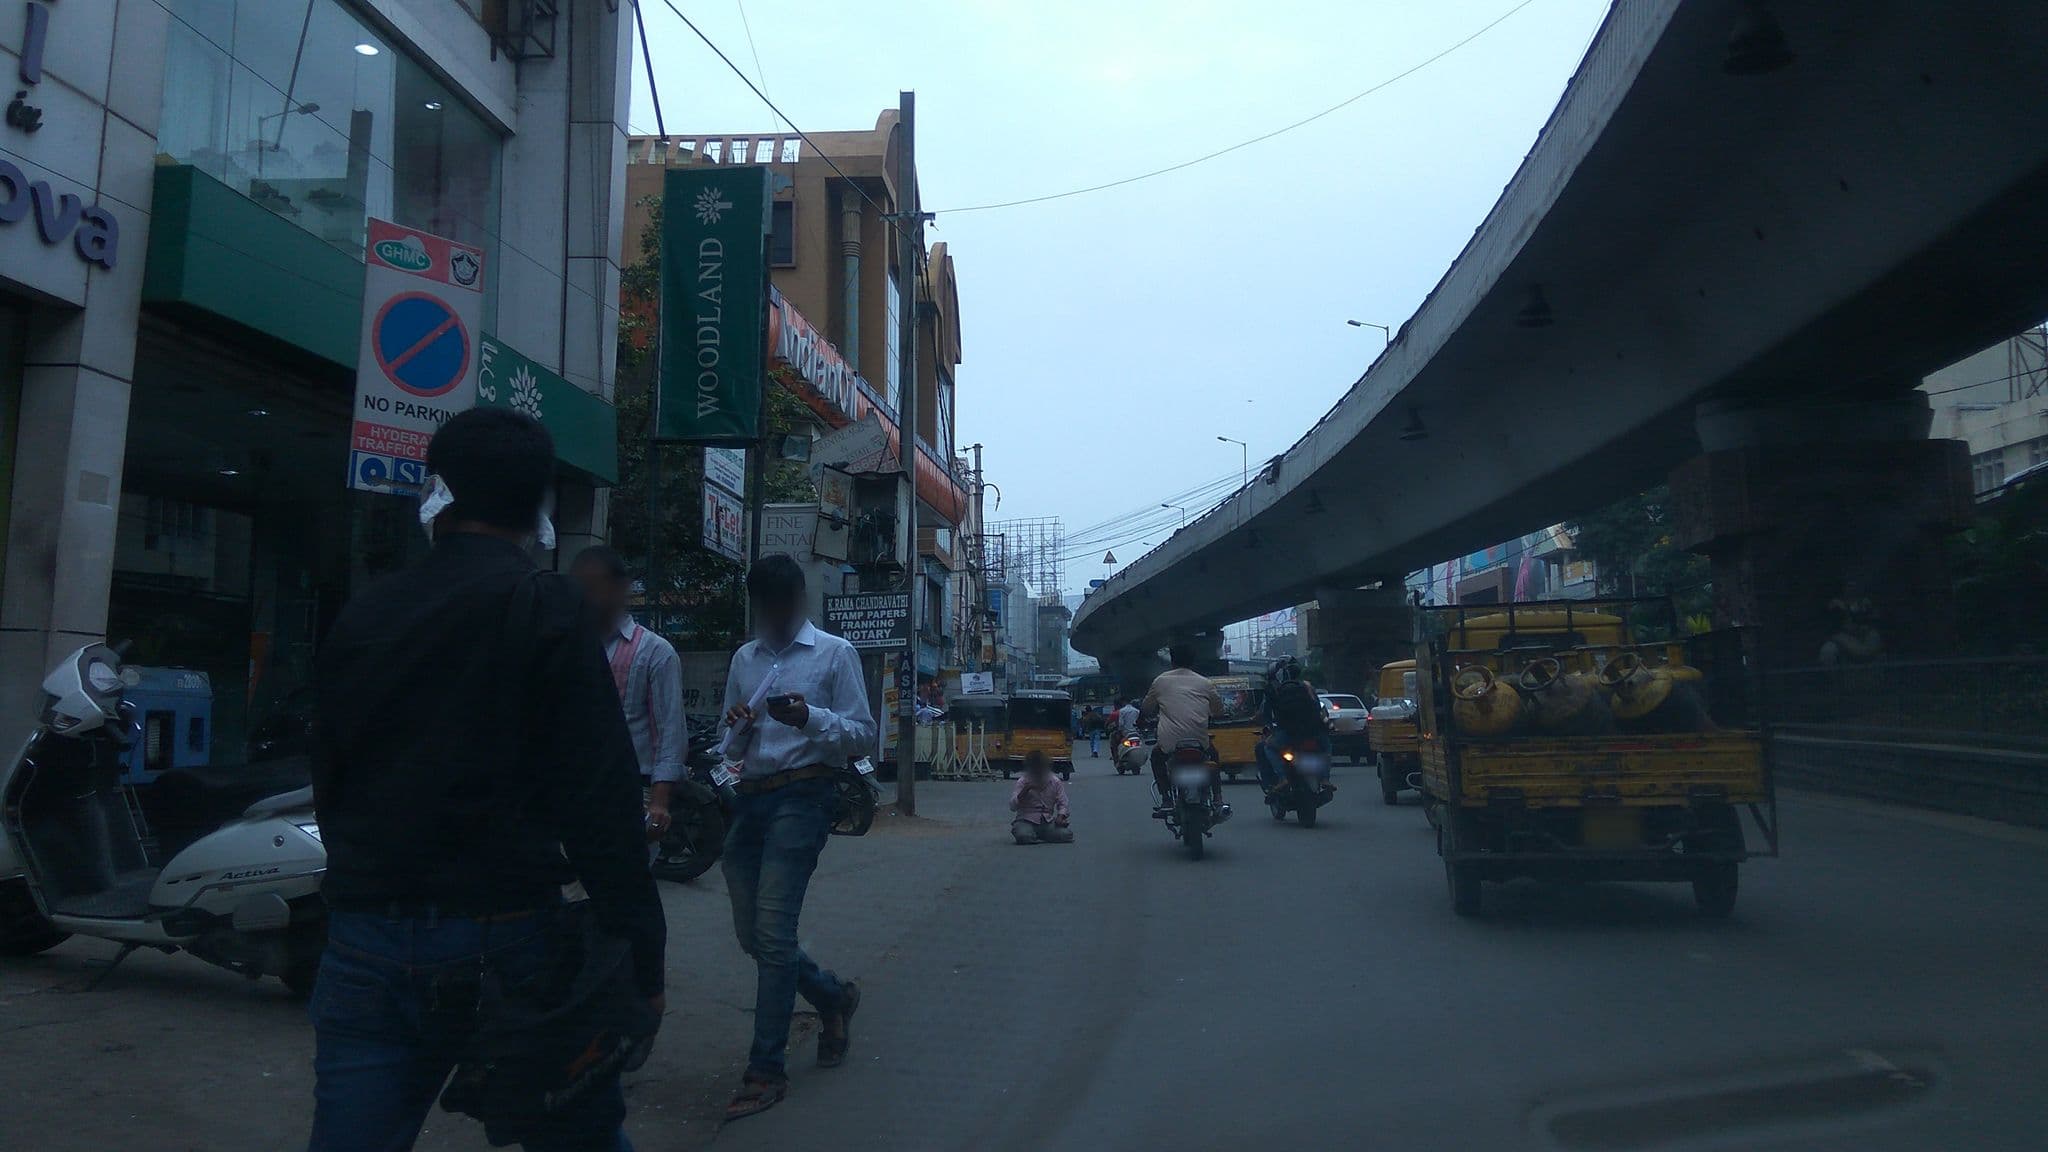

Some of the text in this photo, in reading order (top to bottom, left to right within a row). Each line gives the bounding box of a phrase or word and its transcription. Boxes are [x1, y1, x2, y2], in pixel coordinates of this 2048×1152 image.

[382, 243, 426, 267] GHMC
[697, 238, 723, 418] WOODLAND
[364, 395, 456, 424] NO PARKIN
[370, 426, 431, 446] HYDERA
[357, 436, 416, 457] TRAFFIC
[768, 516, 803, 529] FINE
[856, 594, 909, 610] CHANDRAVATHI
[829, 608, 907, 621] STAMP PAPERS
[841, 619, 895, 630] FRANKING
[843, 628, 892, 641] NOTARY
[219, 867, 280, 881] Activa
